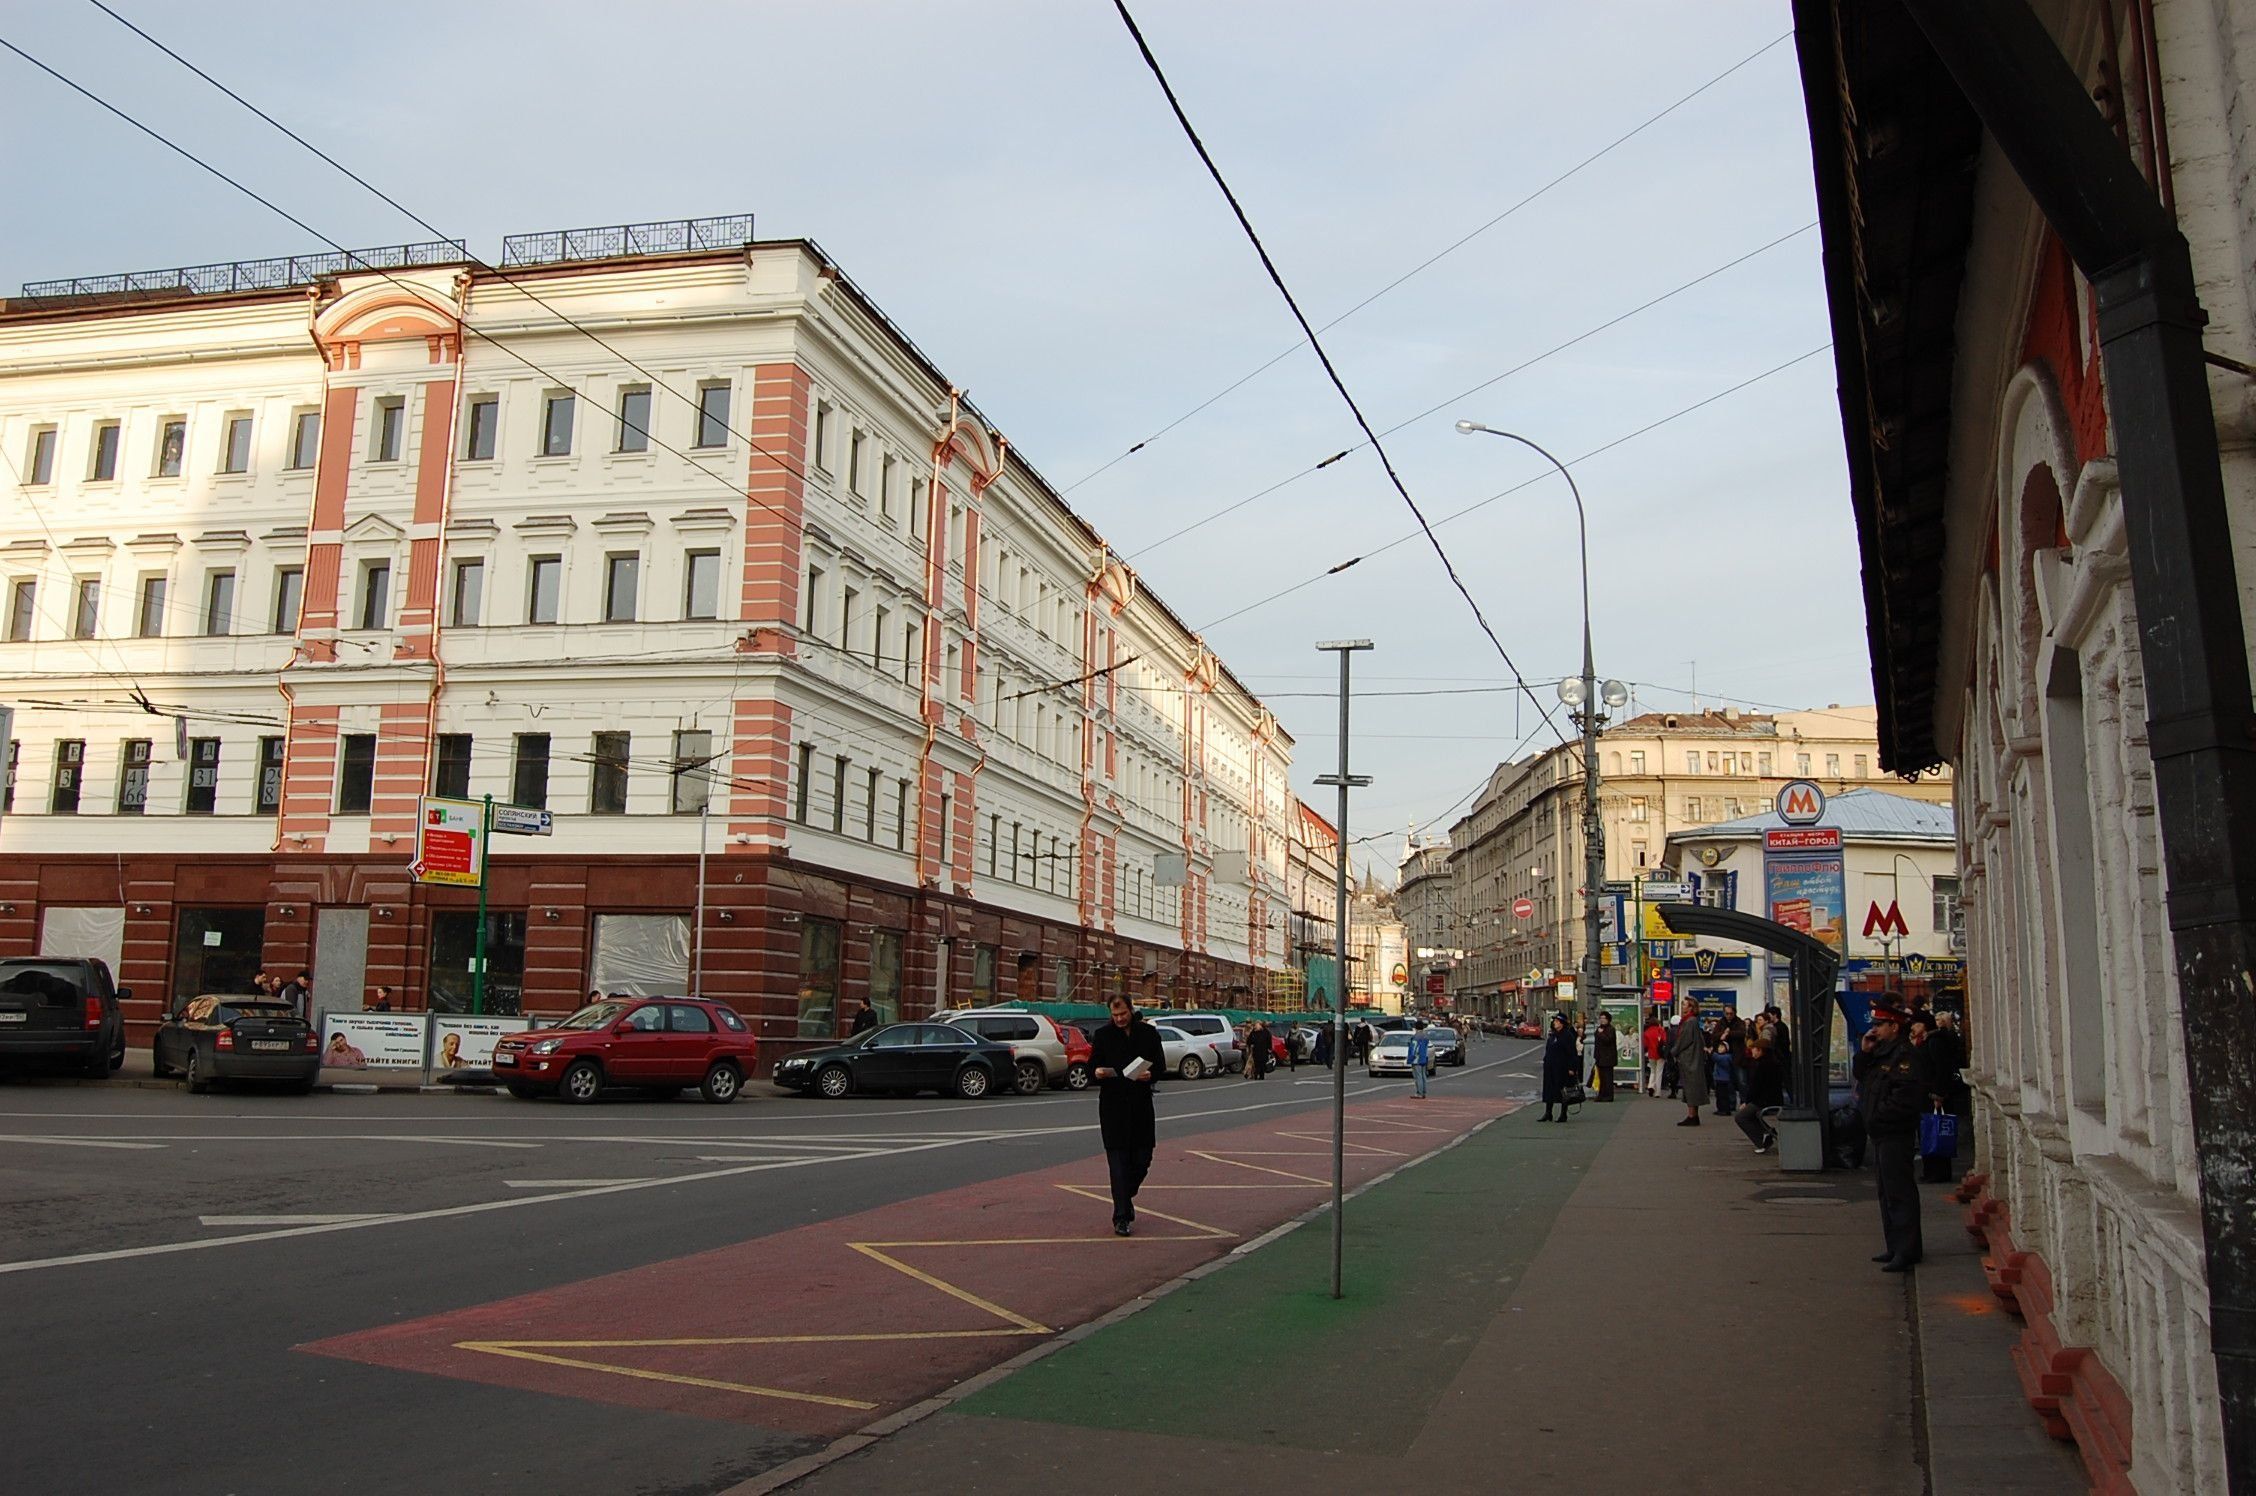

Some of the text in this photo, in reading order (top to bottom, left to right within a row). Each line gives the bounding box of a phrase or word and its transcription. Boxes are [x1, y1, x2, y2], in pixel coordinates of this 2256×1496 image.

[204, 744, 214, 757] Д
[61, 771, 70, 786] 3
[128, 770, 146, 786] 41
[195, 770, 213, 785] 31
[126, 788, 145, 803] 66
[264, 786, 273, 802] 8
[1786, 788, 1817, 814] М
[1862, 900, 1910, 936] М
